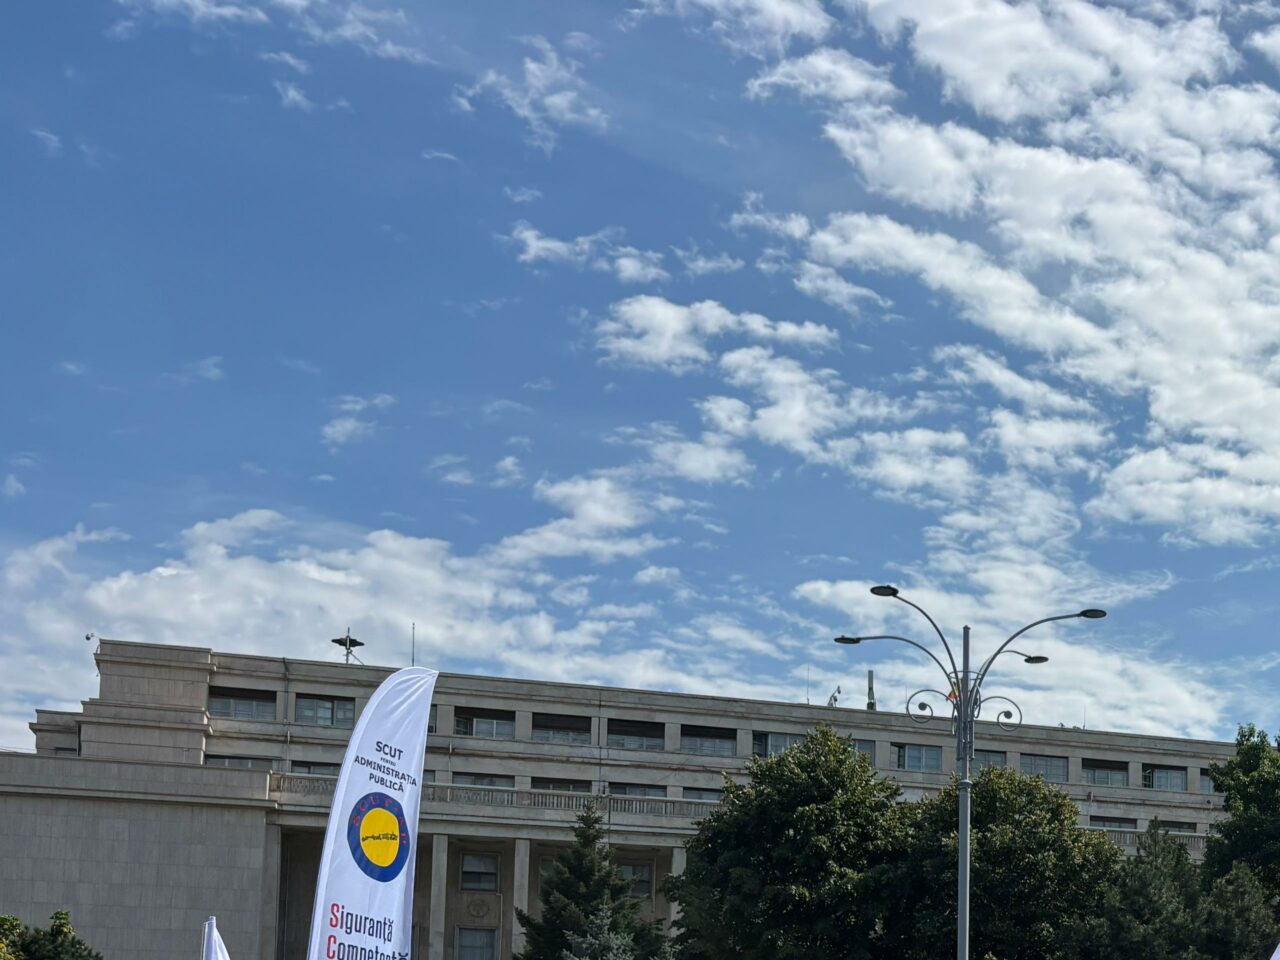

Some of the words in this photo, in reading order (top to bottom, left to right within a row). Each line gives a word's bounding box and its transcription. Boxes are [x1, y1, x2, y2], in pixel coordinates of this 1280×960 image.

[375, 740, 404, 761] SCUT
[369, 772, 404, 793] PUBLICĂ
[329, 903, 394, 943] Siguranță
